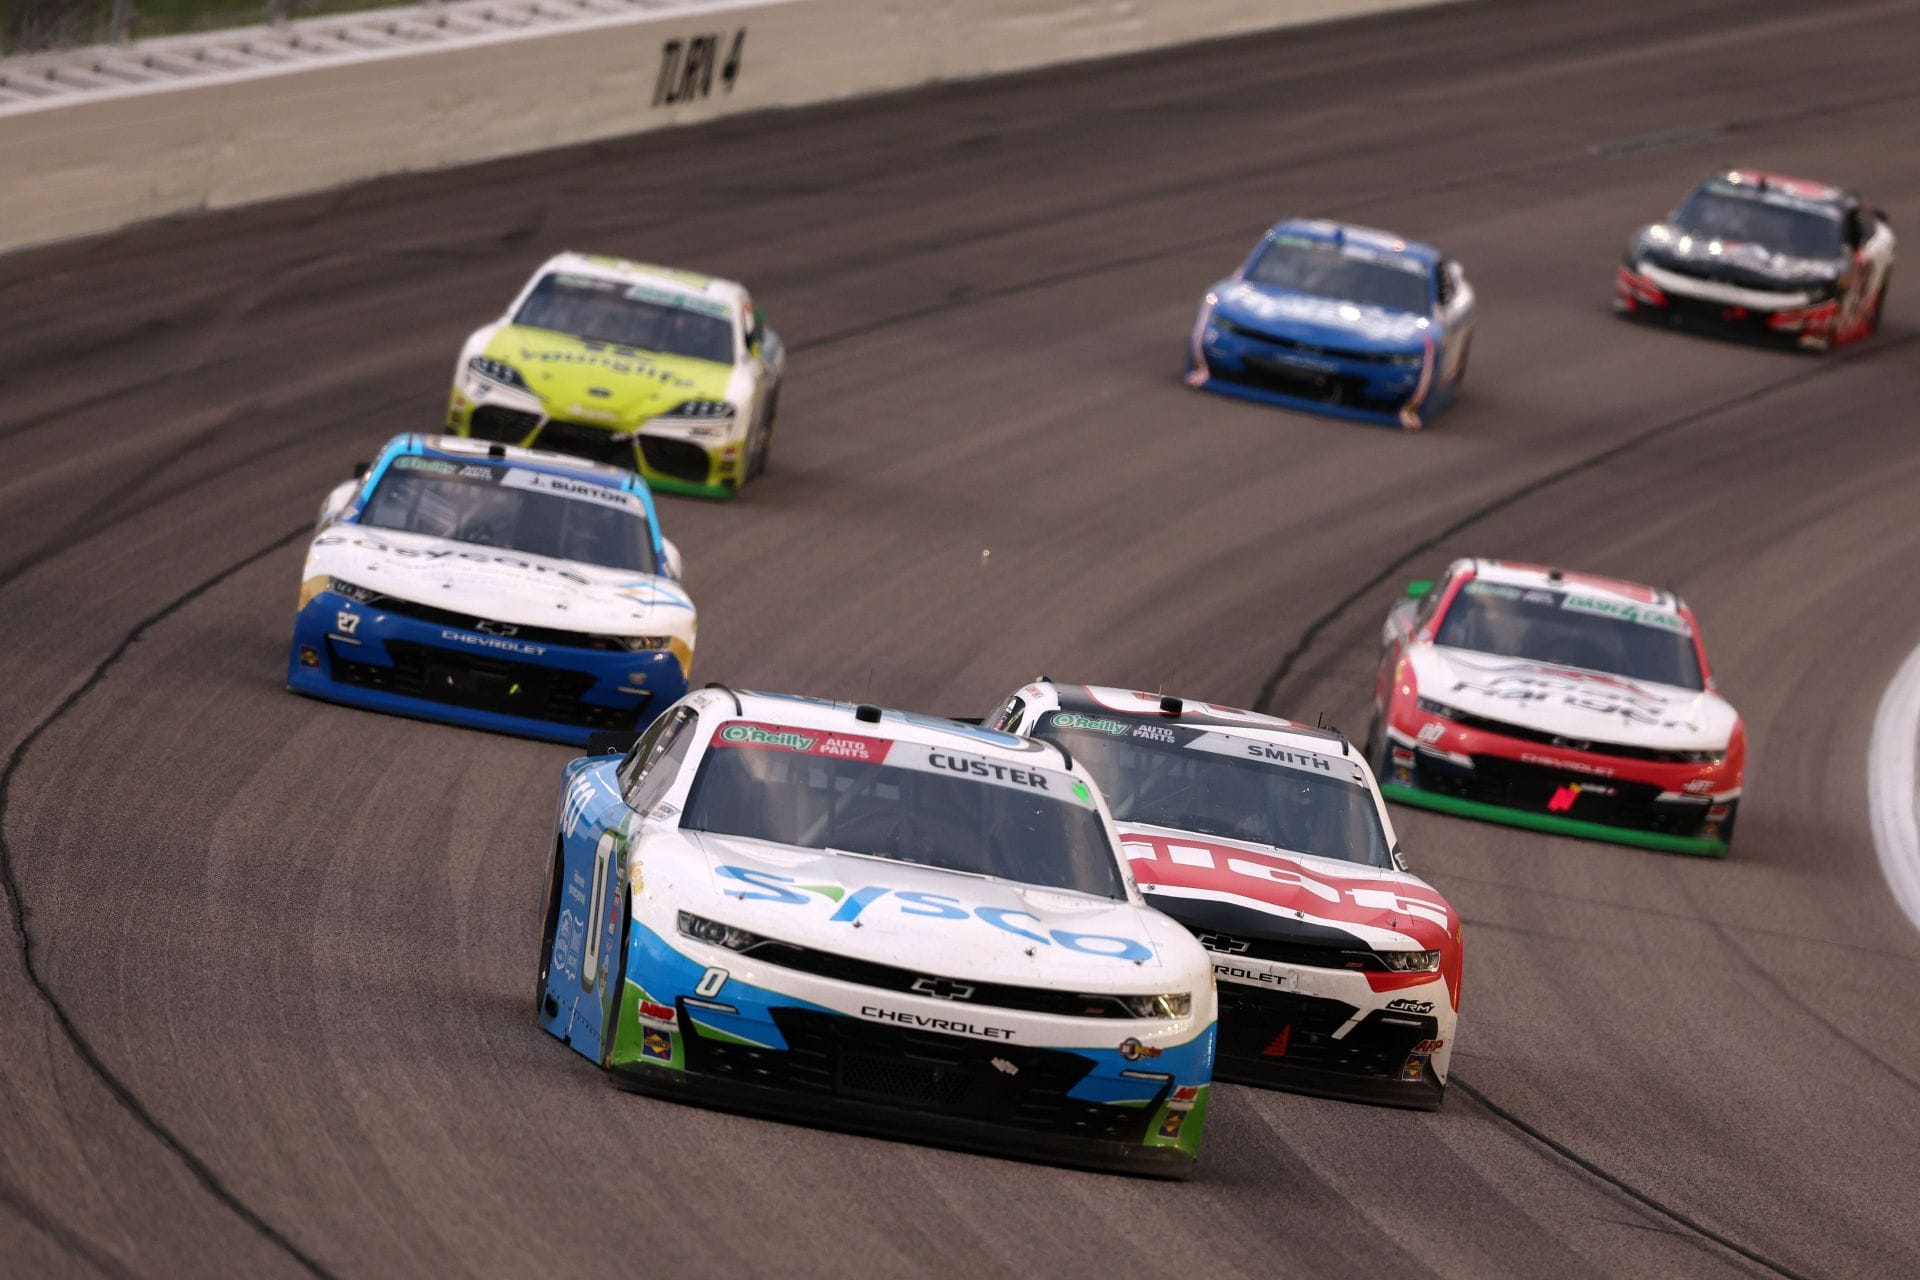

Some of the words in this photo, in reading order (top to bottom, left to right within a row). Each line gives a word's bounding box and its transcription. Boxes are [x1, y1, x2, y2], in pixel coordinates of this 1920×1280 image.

[551, 481, 627, 504] BURTON
[337, 611, 360, 634] 27
[442, 630, 547, 656] CHEVROLET
[1051, 713, 1131, 736] O'Reilly
[1139, 725, 1173, 736] AUTO
[720, 725, 816, 751] O'Reilly
[826, 738, 865, 750] AUTO
[1133, 730, 1176, 743] PARTS
[820, 745, 869, 759] PARTS
[1248, 744, 1330, 771] SMITH
[929, 753, 1048, 790] CUSTER
[581, 832, 617, 990] 0
[715, 866, 1153, 963] sysco
[695, 966, 729, 999] 0
[1215, 965, 1287, 985] ROLET
[1388, 1001, 1434, 1014] JRM
[861, 1006, 1016, 1040] CHEVROLET
